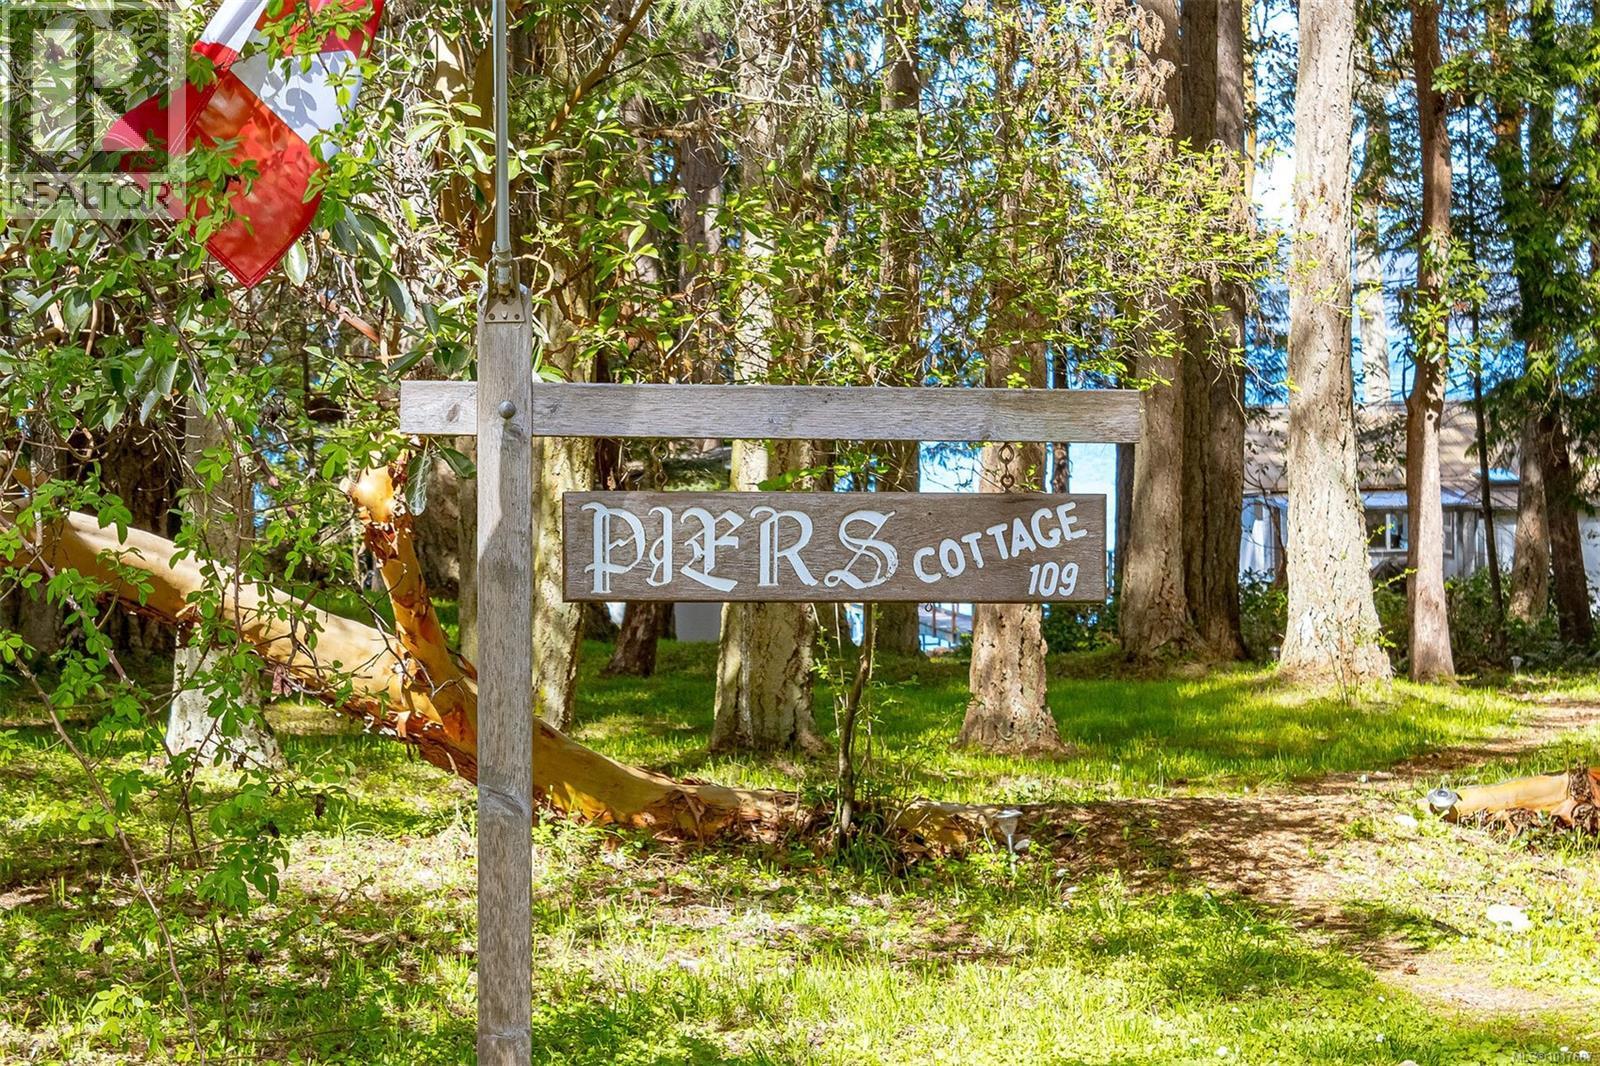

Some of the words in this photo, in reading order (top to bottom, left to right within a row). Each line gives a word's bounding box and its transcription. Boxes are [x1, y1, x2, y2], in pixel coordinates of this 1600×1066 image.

[580, 501, 899, 594] PIERS
[912, 501, 1088, 584] COTTAGE
[1027, 561, 1079, 597] 109
